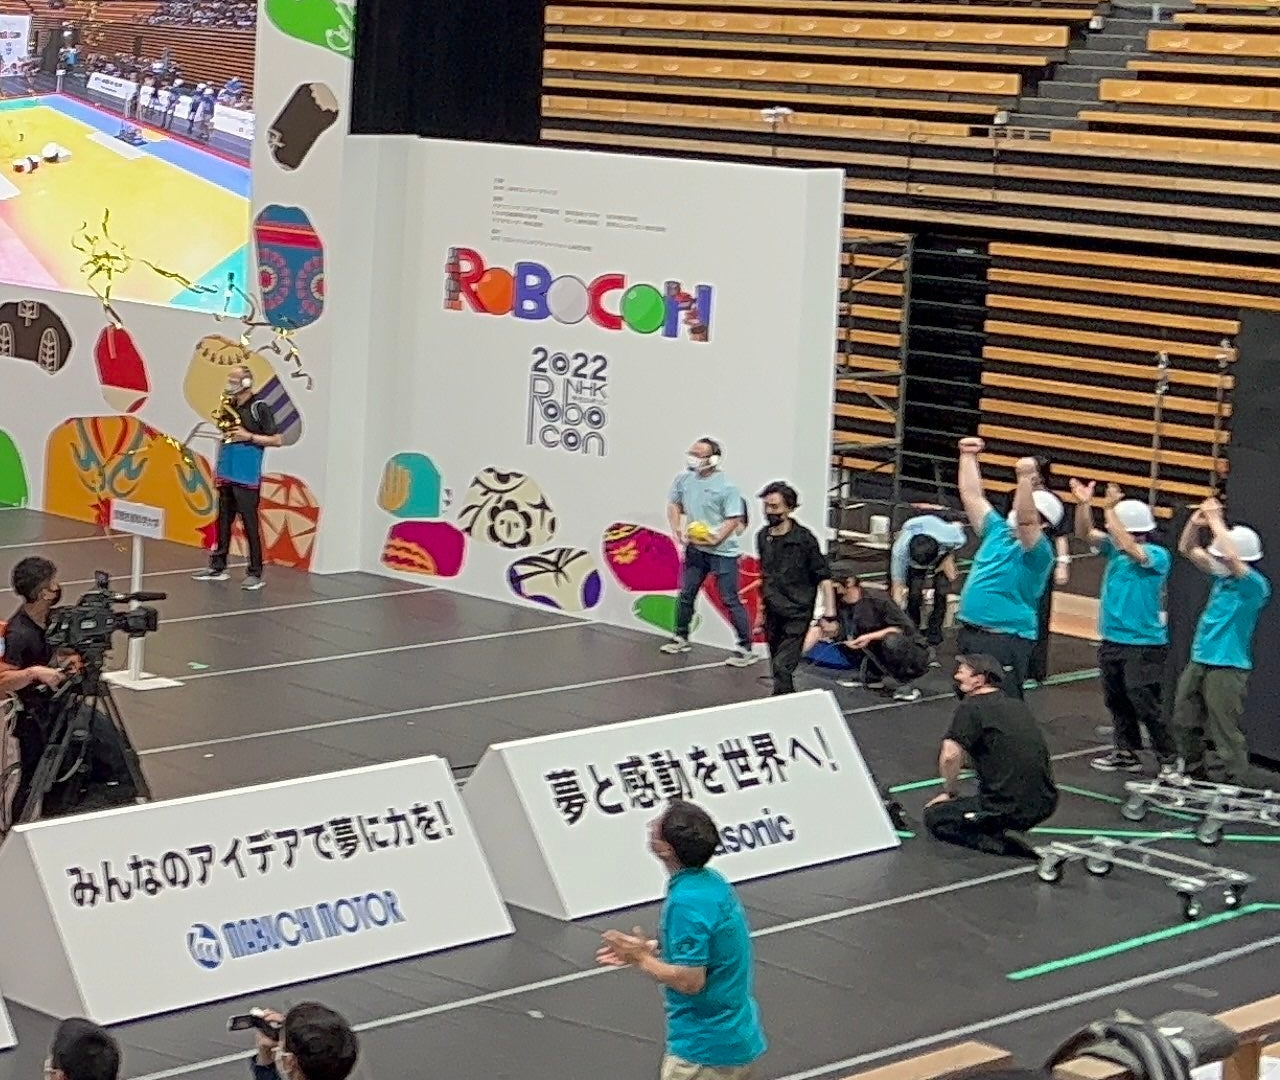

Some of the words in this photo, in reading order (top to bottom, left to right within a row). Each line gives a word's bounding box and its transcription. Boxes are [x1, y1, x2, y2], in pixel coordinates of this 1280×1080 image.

[530, 346, 608, 382] 2022
[544, 725, 840, 826] 夢と感動を世界へ!
[66, 800, 454, 907] みんなのアイデアで夢に力を!
